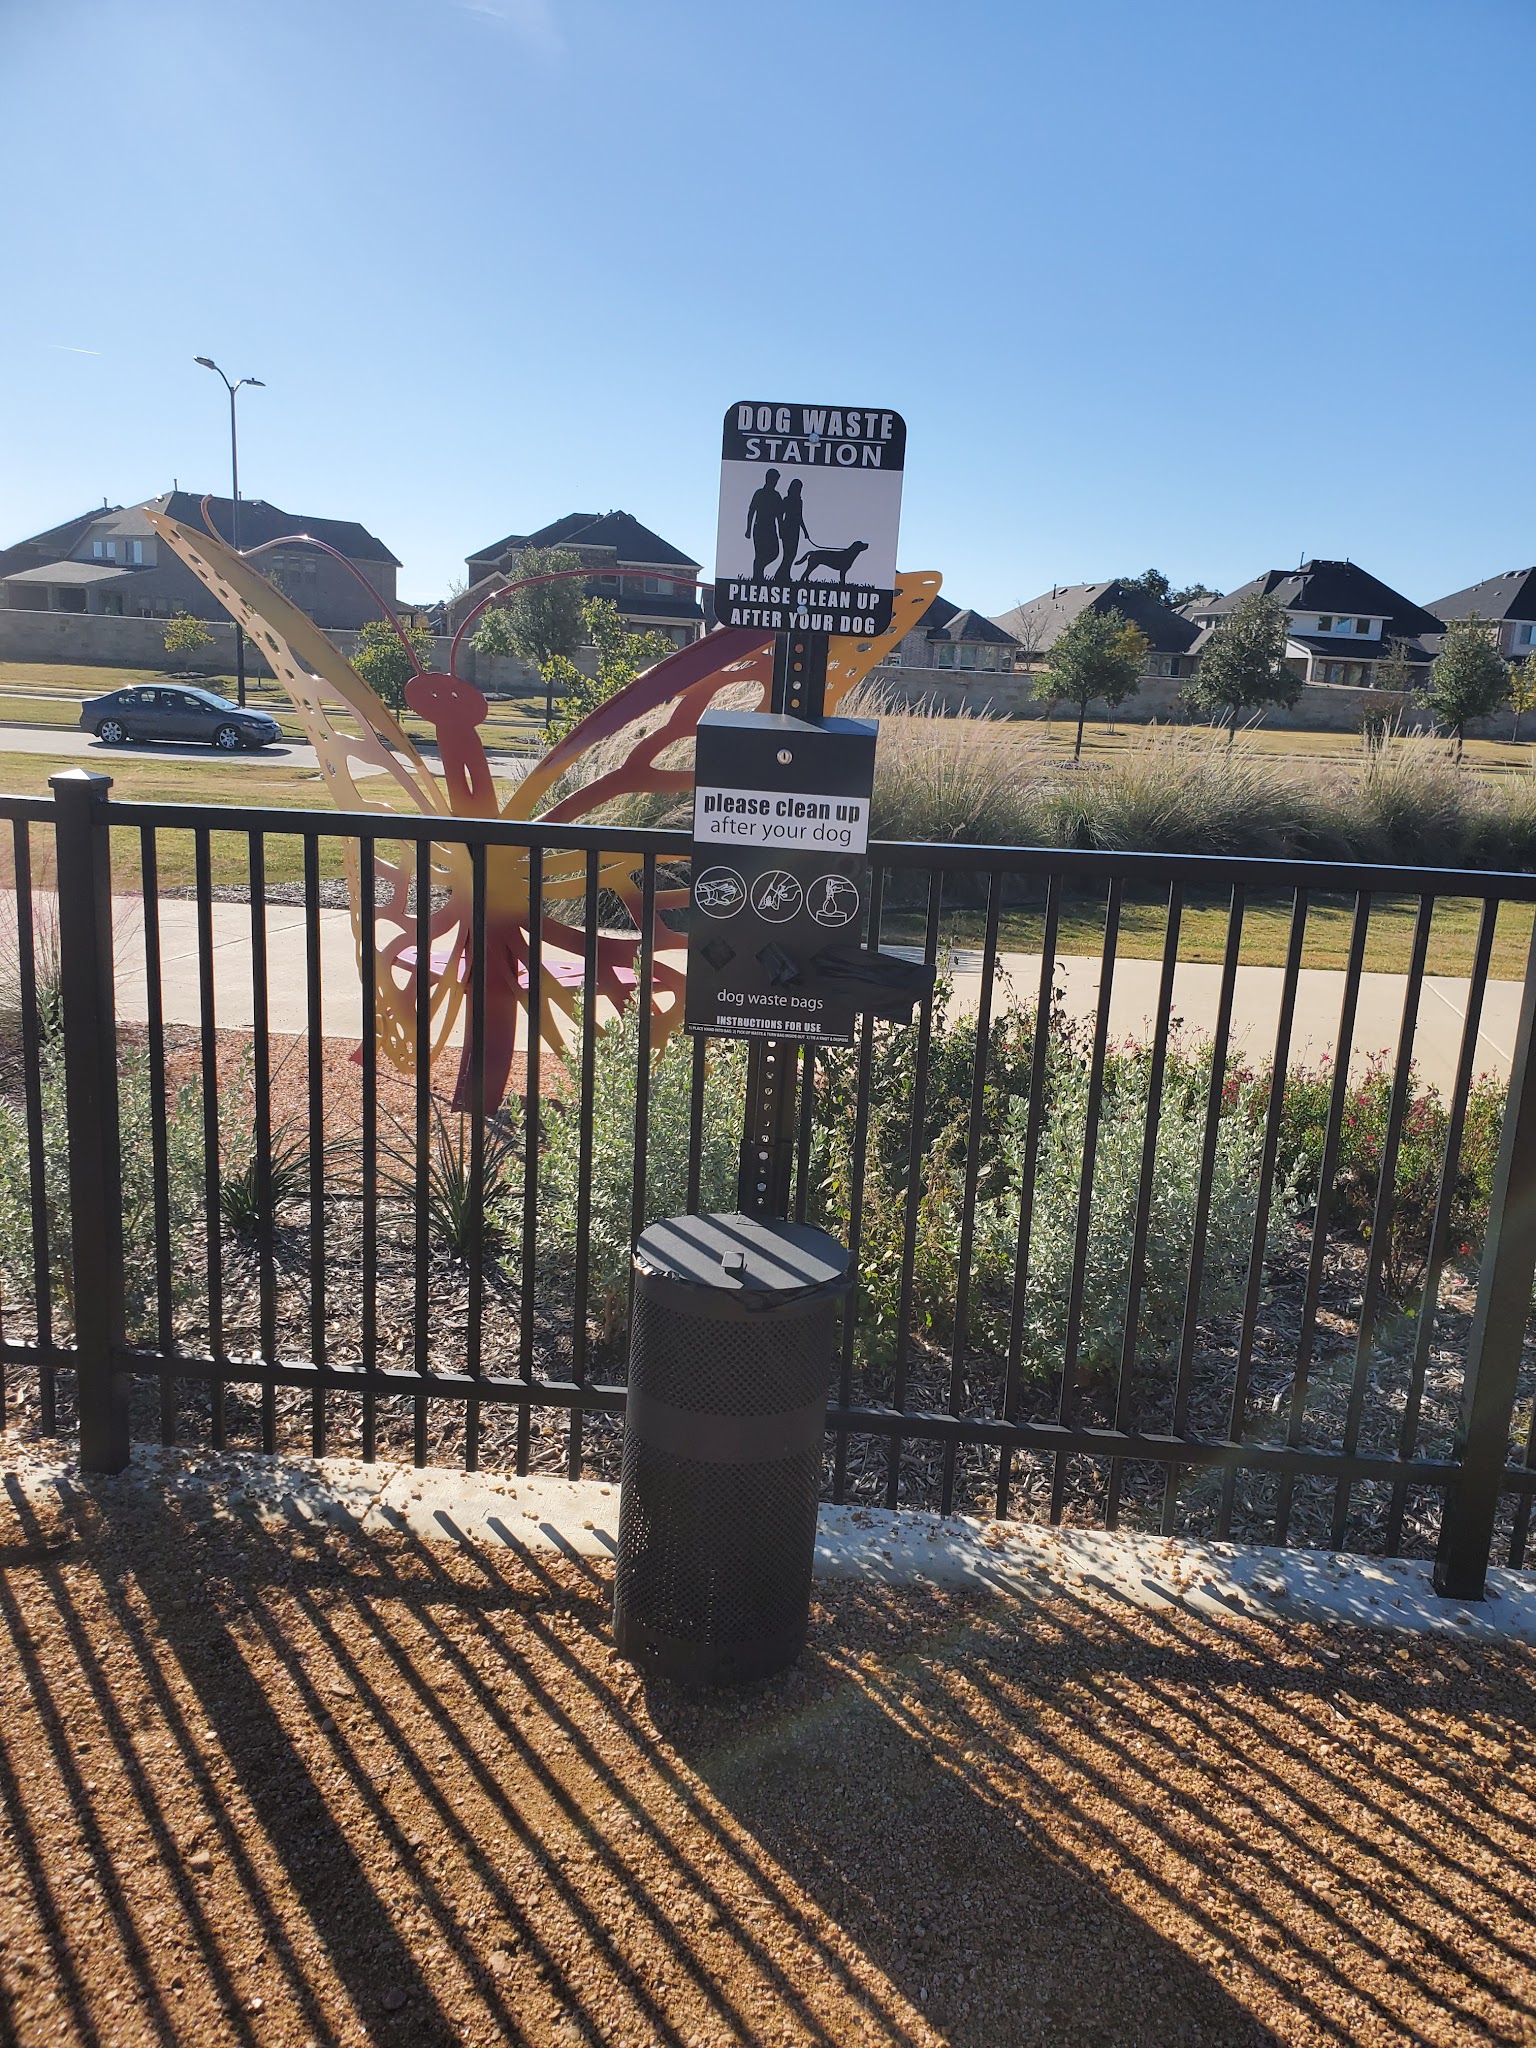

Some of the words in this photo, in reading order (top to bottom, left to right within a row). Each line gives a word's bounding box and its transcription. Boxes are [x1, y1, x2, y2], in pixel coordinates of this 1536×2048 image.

[738, 405, 791, 433] DOG
[802, 409, 893, 439] WASTE
[745, 438, 882, 467] STATION
[729, 583, 790, 605] PLEASE
[797, 588, 850, 608] CLEAN
[857, 593, 880, 610] UP
[730, 608, 781, 628] AFTER
[789, 612, 833, 632] YOUR
[840, 616, 875, 635] DOG
[704, 793, 770, 815] please
[775, 799, 830, 820] clean
[836, 804, 860, 824] up
[710, 816, 756, 836] after
[762, 823, 808, 841] your
[813, 823, 852, 847] dog
[717, 989, 744, 1006] dog
[748, 994, 787, 1006] waste
[791, 996, 823, 1012] bags
[716, 1015, 783, 1030] INSTRUCTIONS
[785, 1021, 801, 1031] FOR
[804, 1022, 822, 1033] USE
